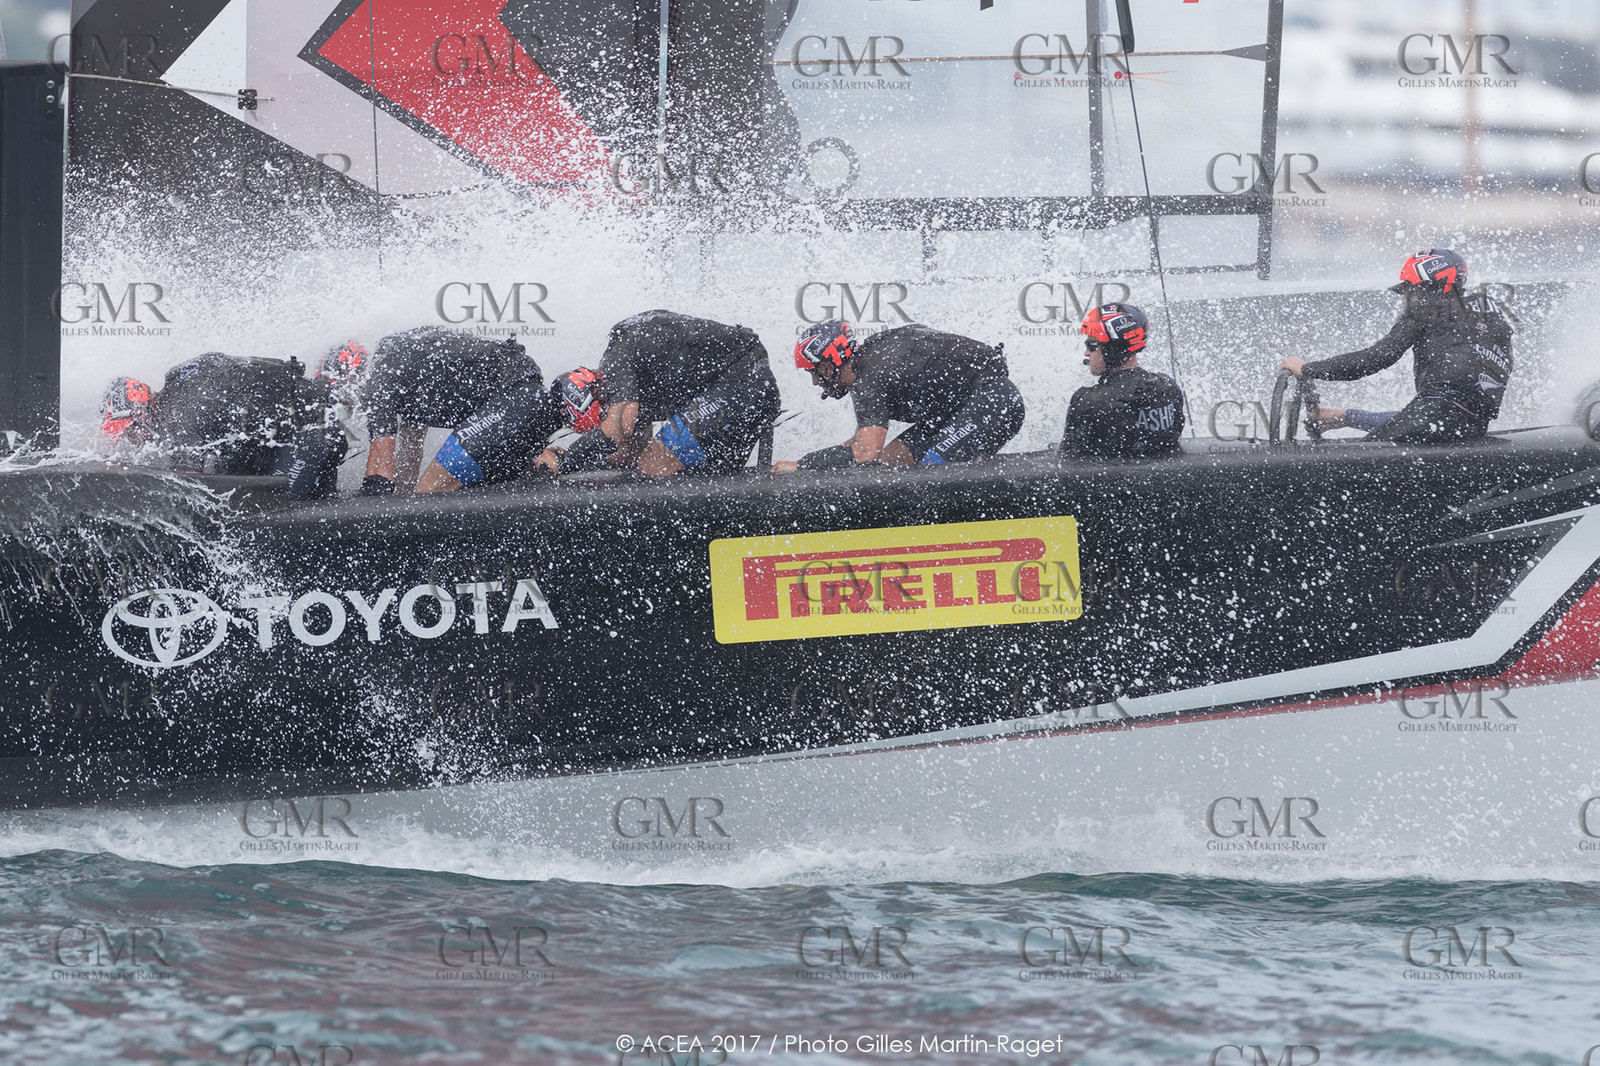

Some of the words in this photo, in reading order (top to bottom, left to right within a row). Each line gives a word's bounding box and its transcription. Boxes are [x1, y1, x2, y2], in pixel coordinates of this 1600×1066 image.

[1434, 266, 1457, 294] 7
[1123, 327, 1145, 352] 3
[936, 423, 978, 452] Emirates
[742, 537, 1047, 621] PIRELLI
[240, 578, 560, 650] TOYOTA
